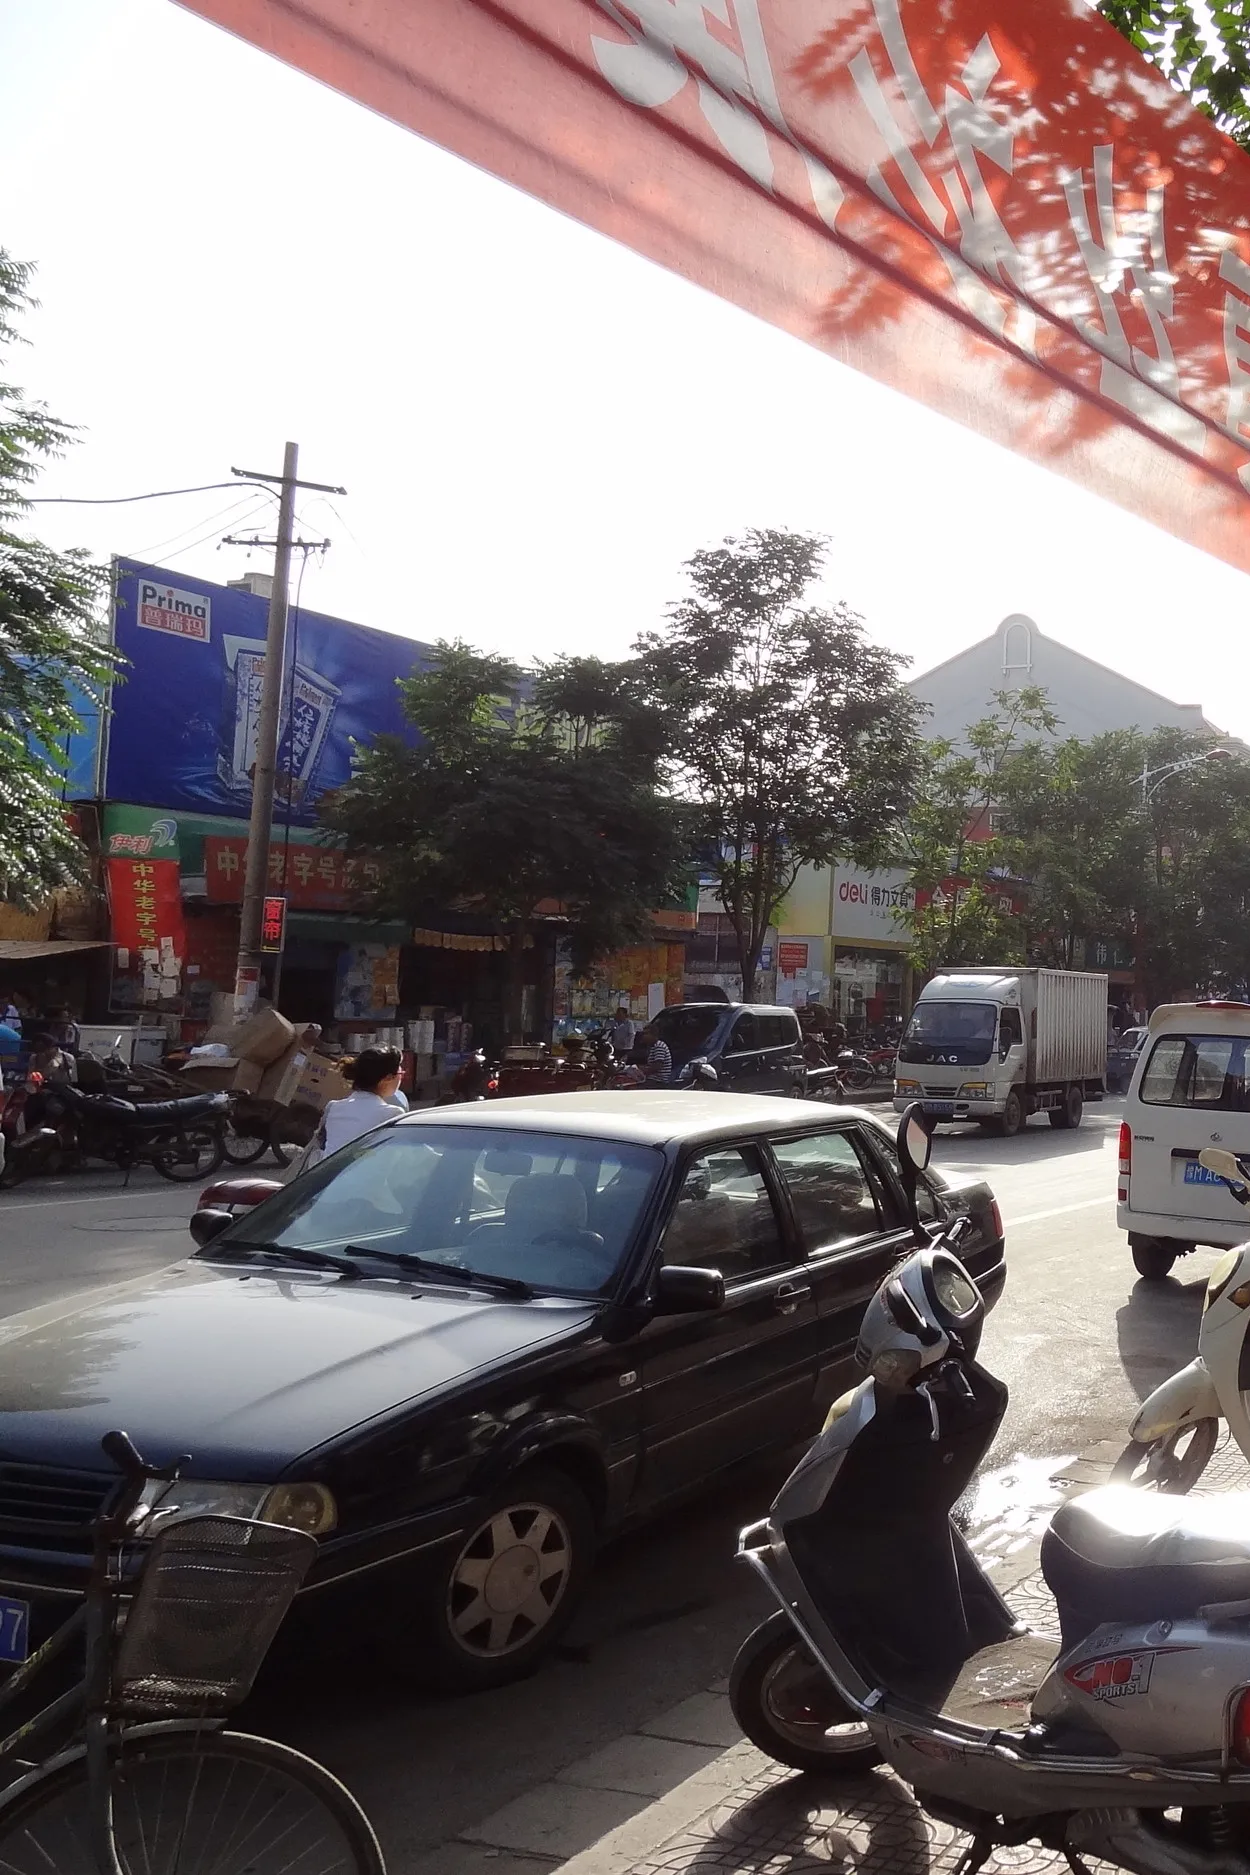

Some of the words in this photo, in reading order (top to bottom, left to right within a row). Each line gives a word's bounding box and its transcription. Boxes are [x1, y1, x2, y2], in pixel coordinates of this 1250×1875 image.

[142, 585, 206, 618] Prima
[145, 608, 203, 636] 普瑞玛
[109, 833, 153, 854] 伊利
[839, 881, 868, 904] deli
[132, 863, 159, 952] 中华老字号
[264, 900, 283, 940] 窗帘
[926, 1054, 959, 1063] JAC
[1092, 1652, 1157, 1694] NO.1
[1093, 1683, 1137, 1701] SPORTS
